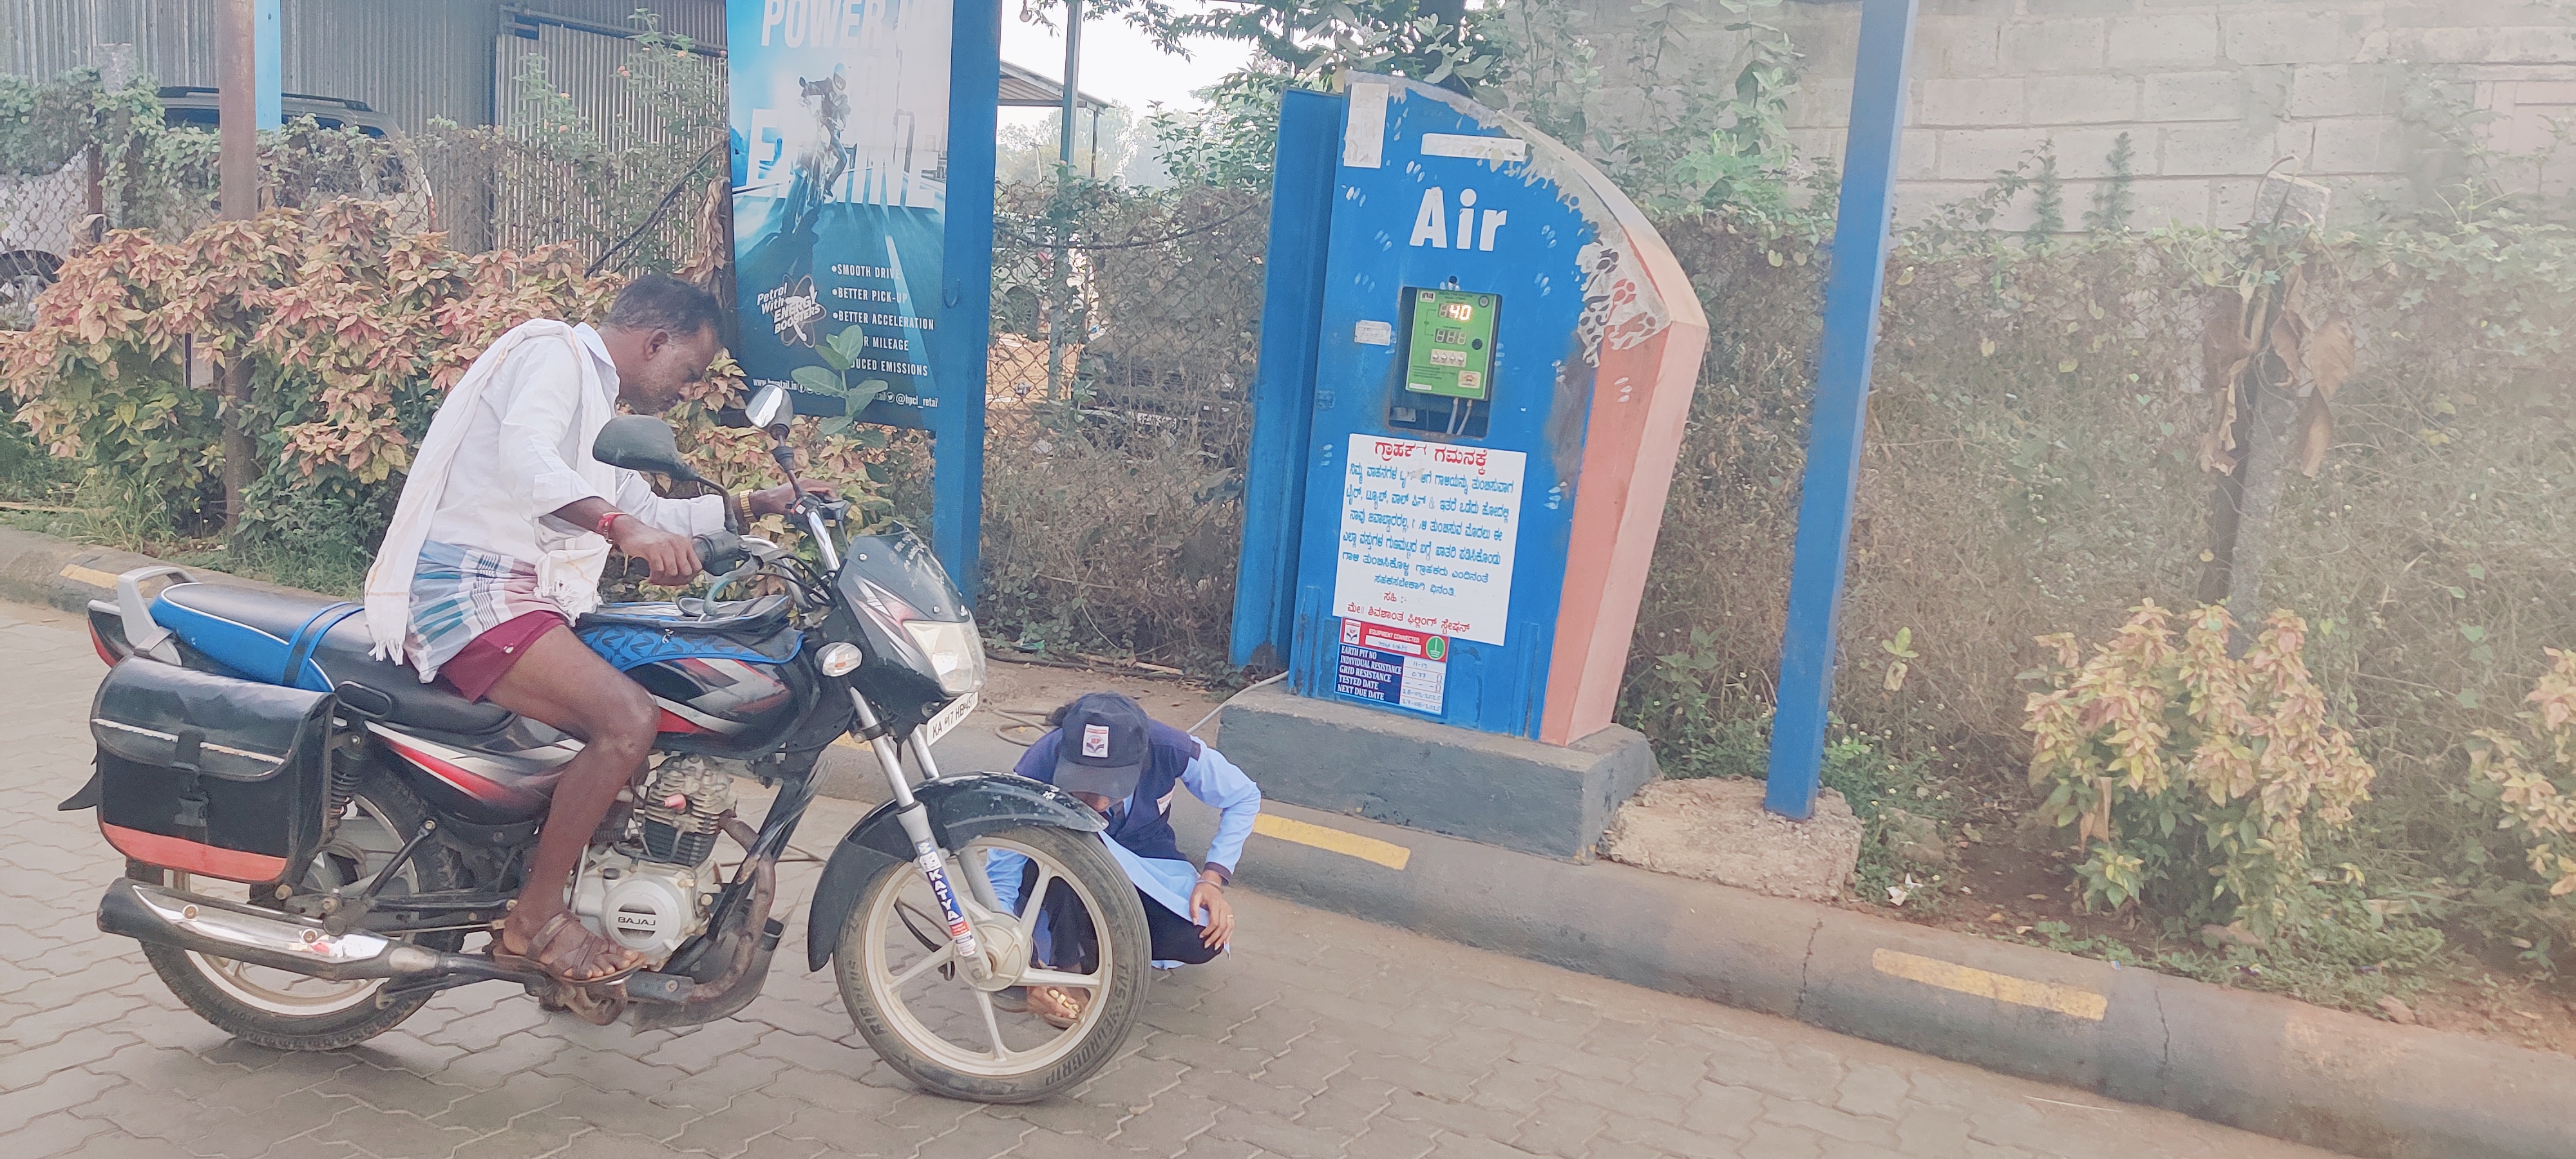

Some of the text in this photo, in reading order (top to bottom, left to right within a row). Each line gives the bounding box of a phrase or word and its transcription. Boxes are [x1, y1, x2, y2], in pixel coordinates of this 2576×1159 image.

[761, 0, 886, 49] POWER
[1409, 187, 1507, 252] Air
[837, 263, 900, 280] SMOOTH DRIVE
[757, 282, 788, 306] Petrol
[838, 287, 908, 304] BETTER PICK-UP
[761, 297, 785, 315] With
[773, 290, 819, 323] ENERGY
[1449, 303, 1472, 321] 40
[774, 305, 820, 335] BOOSTERS
[838, 310, 934, 330] BETTER ACCELERATION
[873, 336, 909, 352] MILEAGE
[881, 361, 928, 377] EMISSIONS
[1434, 446, 1488, 475] ಗಮನಕ್ಕೆ
[1349, 462, 1363, 484] ನಿಮ್ಮ
[1428, 496, 1435, 509] &
[1383, 591, 1397, 603] ಸಹಿ
[1368, 606, 1404, 621] ಶಿವಶಾಂತ
[1341, 645, 1377, 659] EARTH PIT NO
[1340, 655, 1402, 675] INDIVIDUAL RESISTANCE
[1340, 664, 1392, 683] GRID RESISTANCE
[1339, 674, 1379, 690] TESTED DATE
[1337, 683, 1385, 701] NEXT DUE DATE
[933, 721, 943, 739] KA
[928, 869, 960, 921] KATYA
[618, 916, 656, 926] BAJAJ
[1045, 963, 1130, 1086] TVS EUROGRIP
